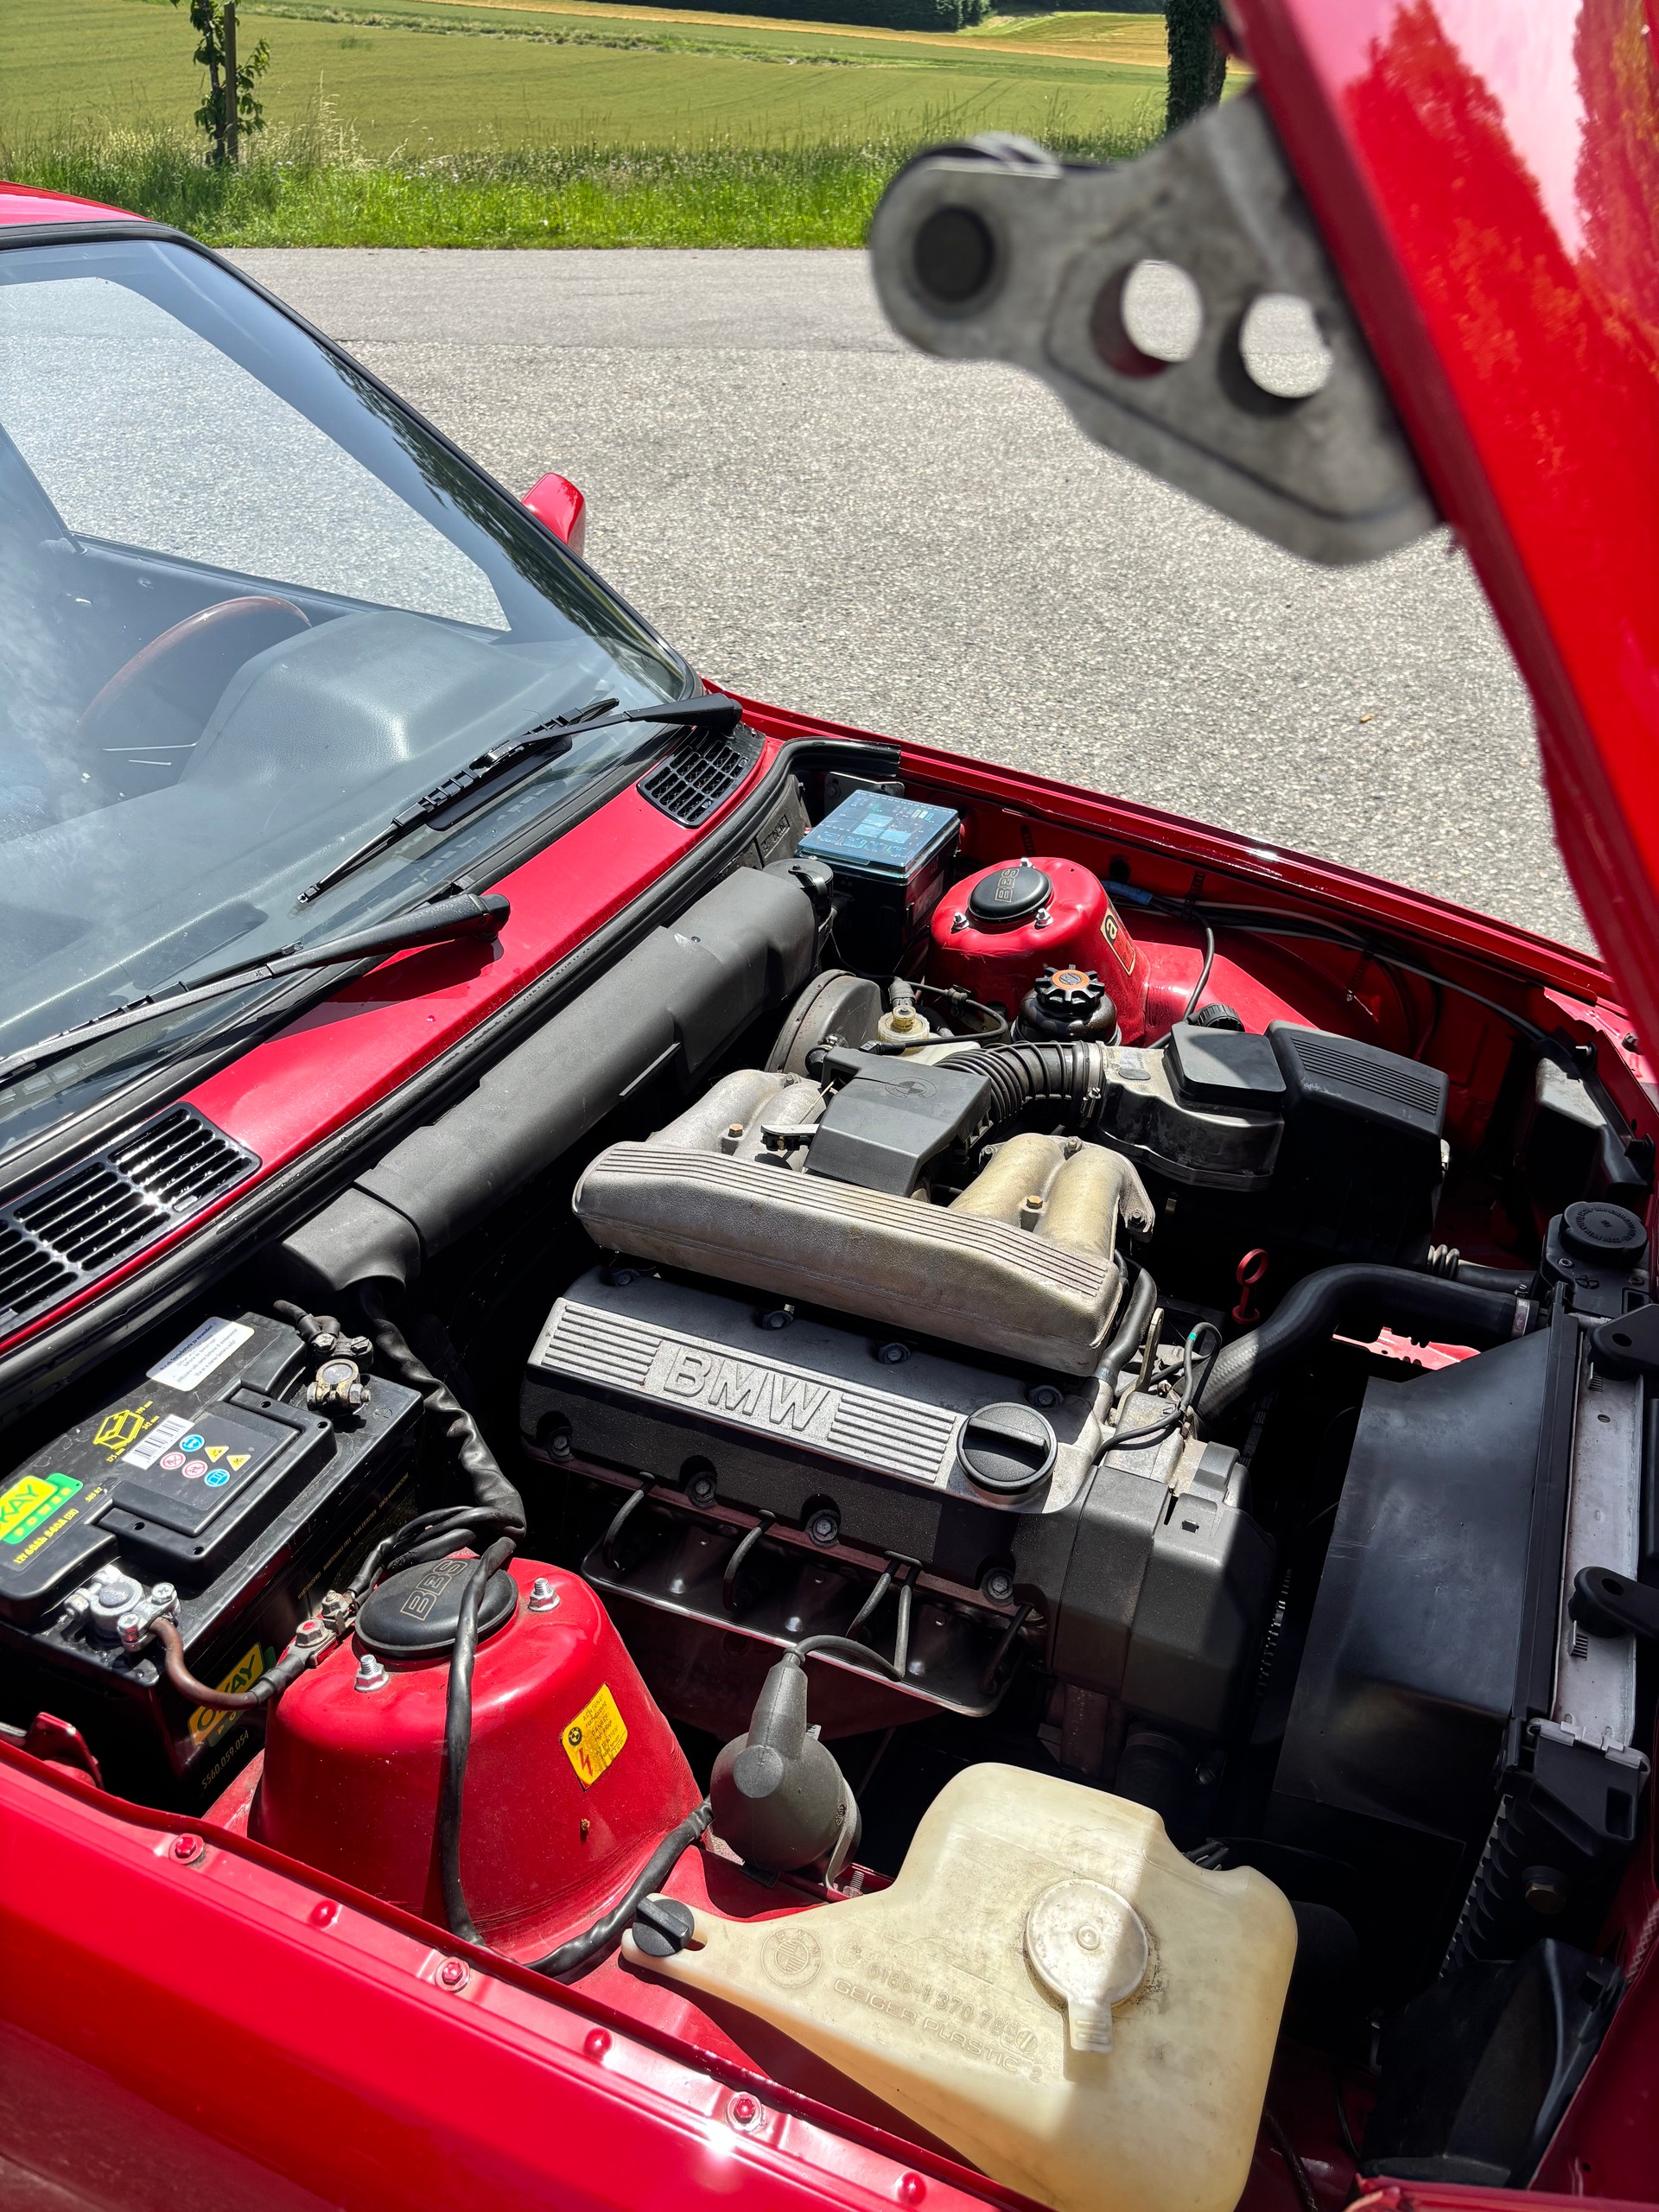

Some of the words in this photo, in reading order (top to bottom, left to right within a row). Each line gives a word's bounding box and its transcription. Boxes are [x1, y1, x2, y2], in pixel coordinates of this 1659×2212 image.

[995, 868, 1020, 903] BBS
[663, 1345, 831, 1432] BMW
[0, 1484, 39, 1524] KAY
[14, 1487, 73, 1536] POWER
[400, 1560, 467, 1621] BBS
[197, 1654, 256, 1732] OAY
[201, 1730, 250, 1789] S560.059.054
[834, 1977, 918, 2027] GEIGER
[923, 2017, 1020, 2074] PLASTIC
